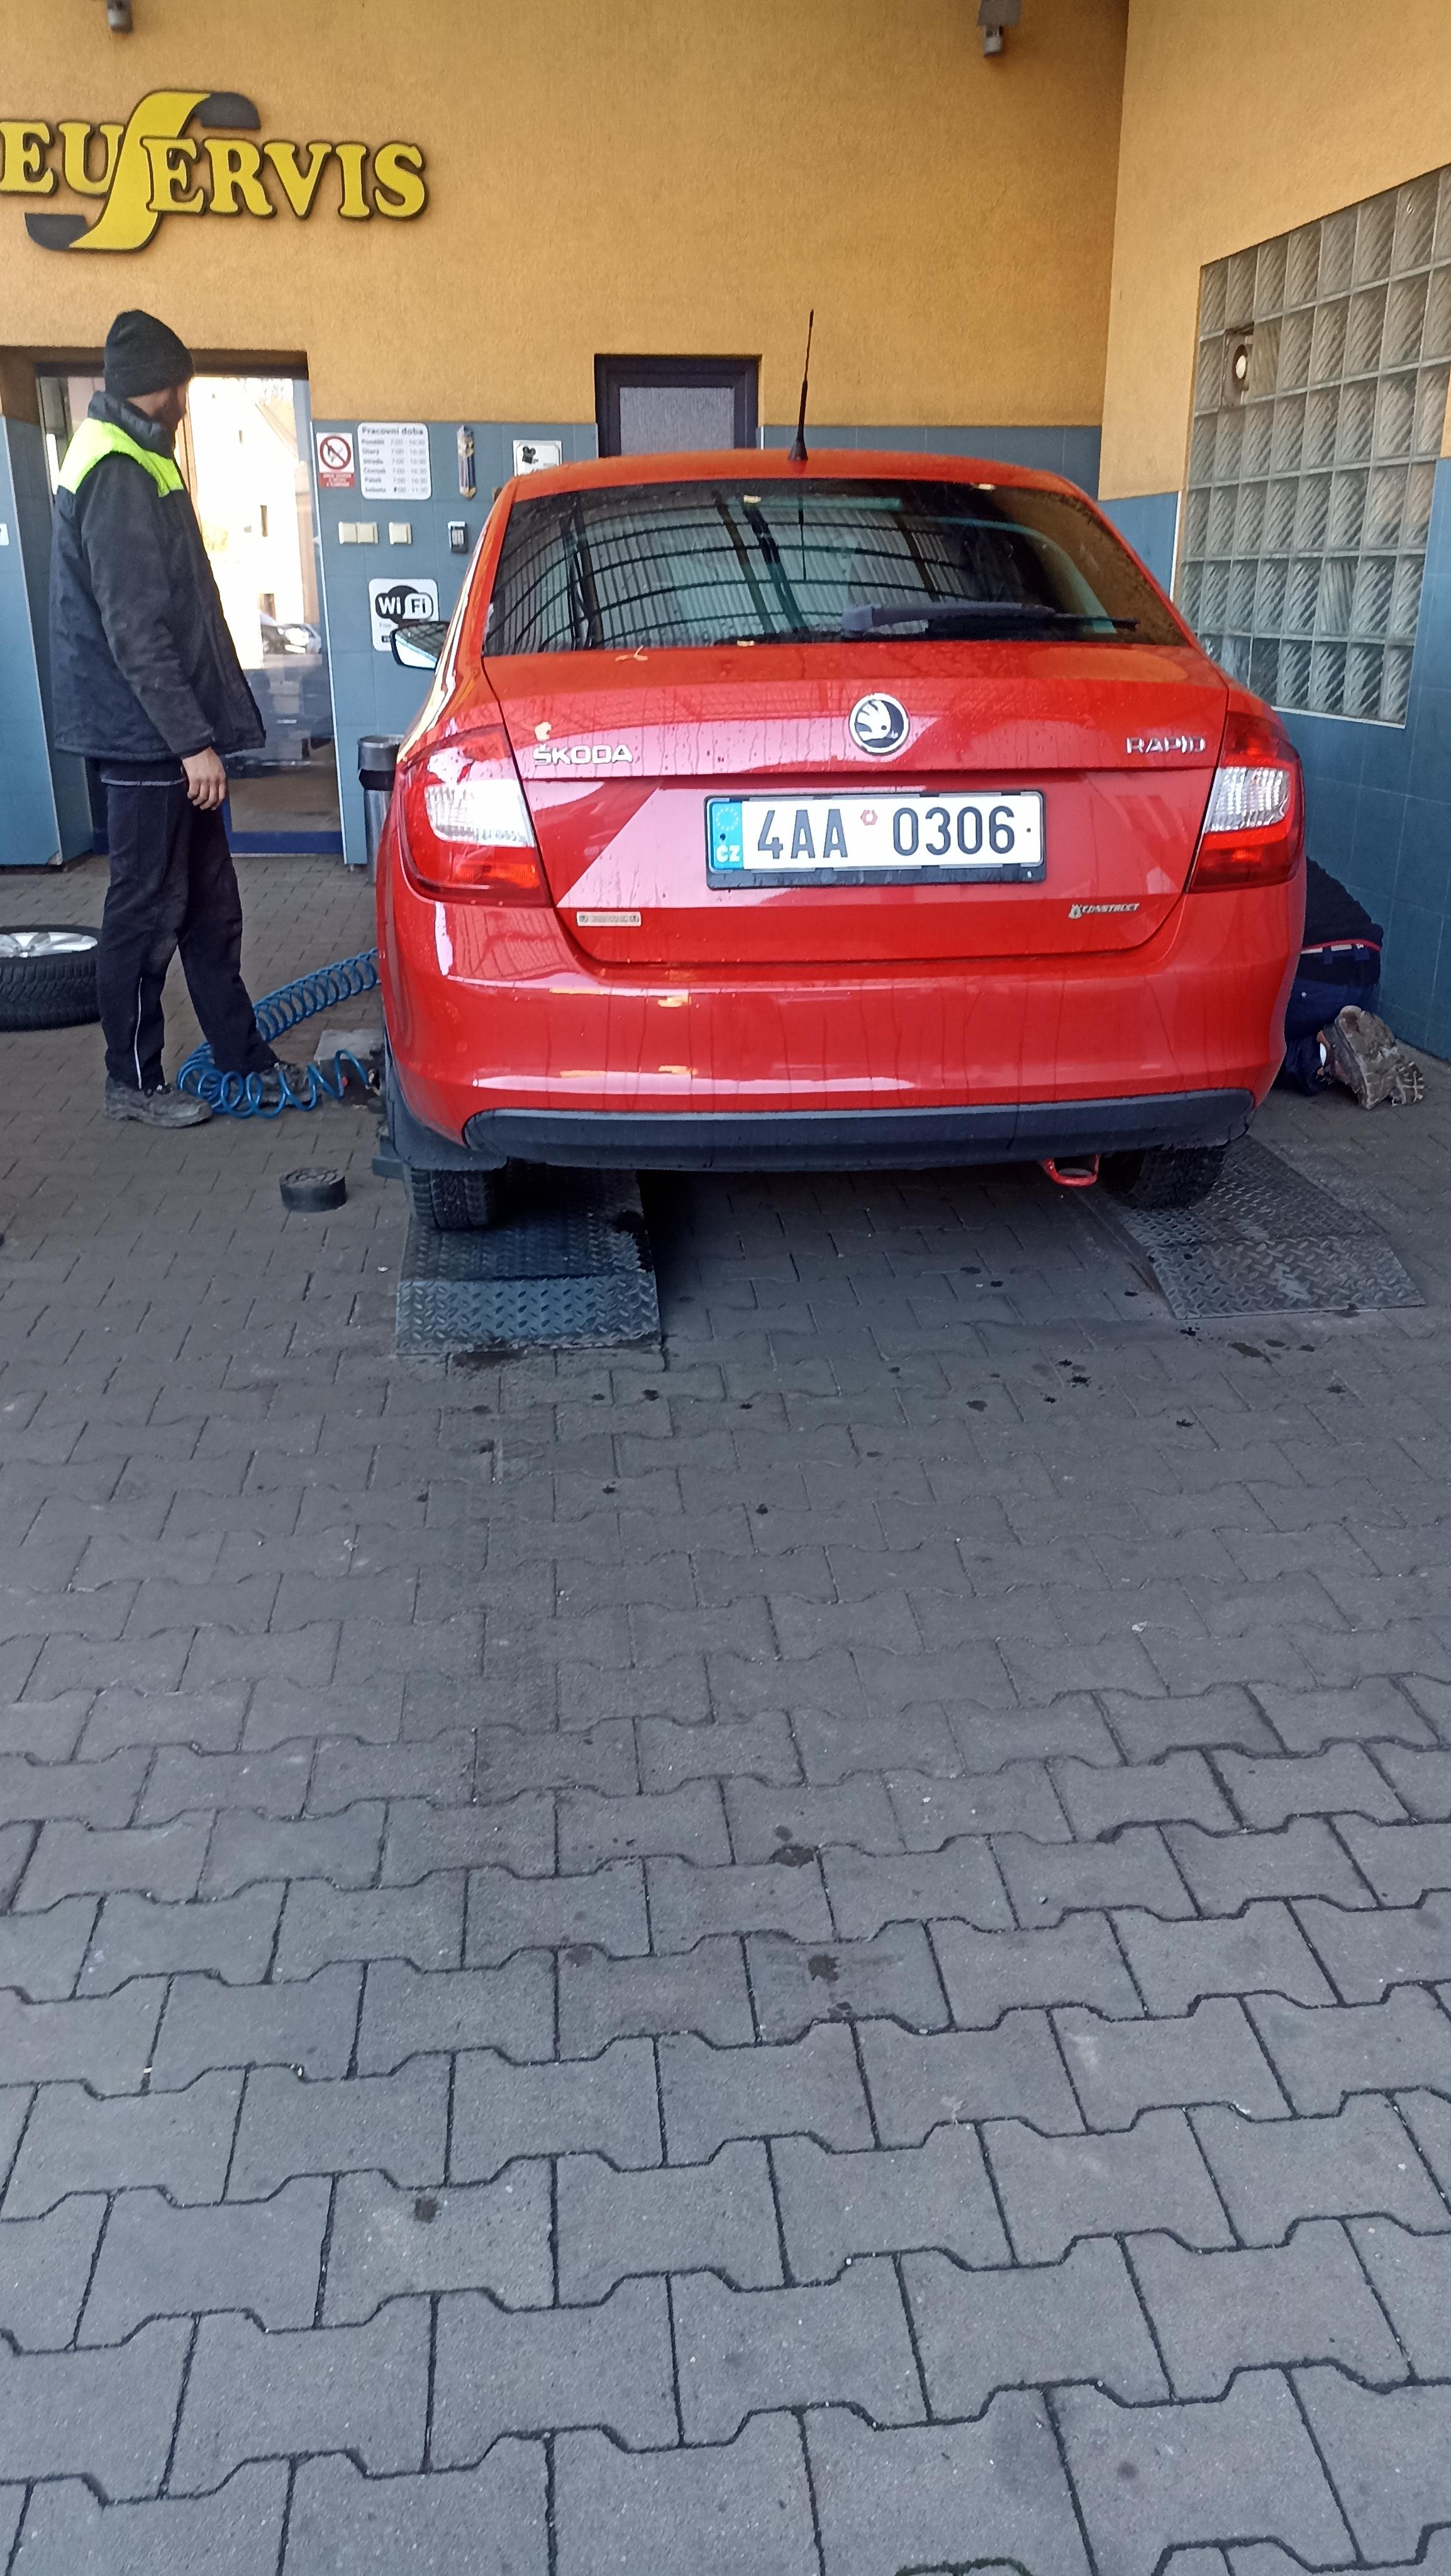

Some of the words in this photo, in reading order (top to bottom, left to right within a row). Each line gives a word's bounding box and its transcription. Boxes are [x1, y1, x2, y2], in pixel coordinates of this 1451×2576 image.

[401, 427, 423, 435] doba
[1126, 735, 1206, 753] RAPID
[533, 744, 633, 765] ŠKODA
[757, 809, 848, 860] 4AA
[893, 806, 1015, 857] 0306
[716, 845, 740, 862] CZ
